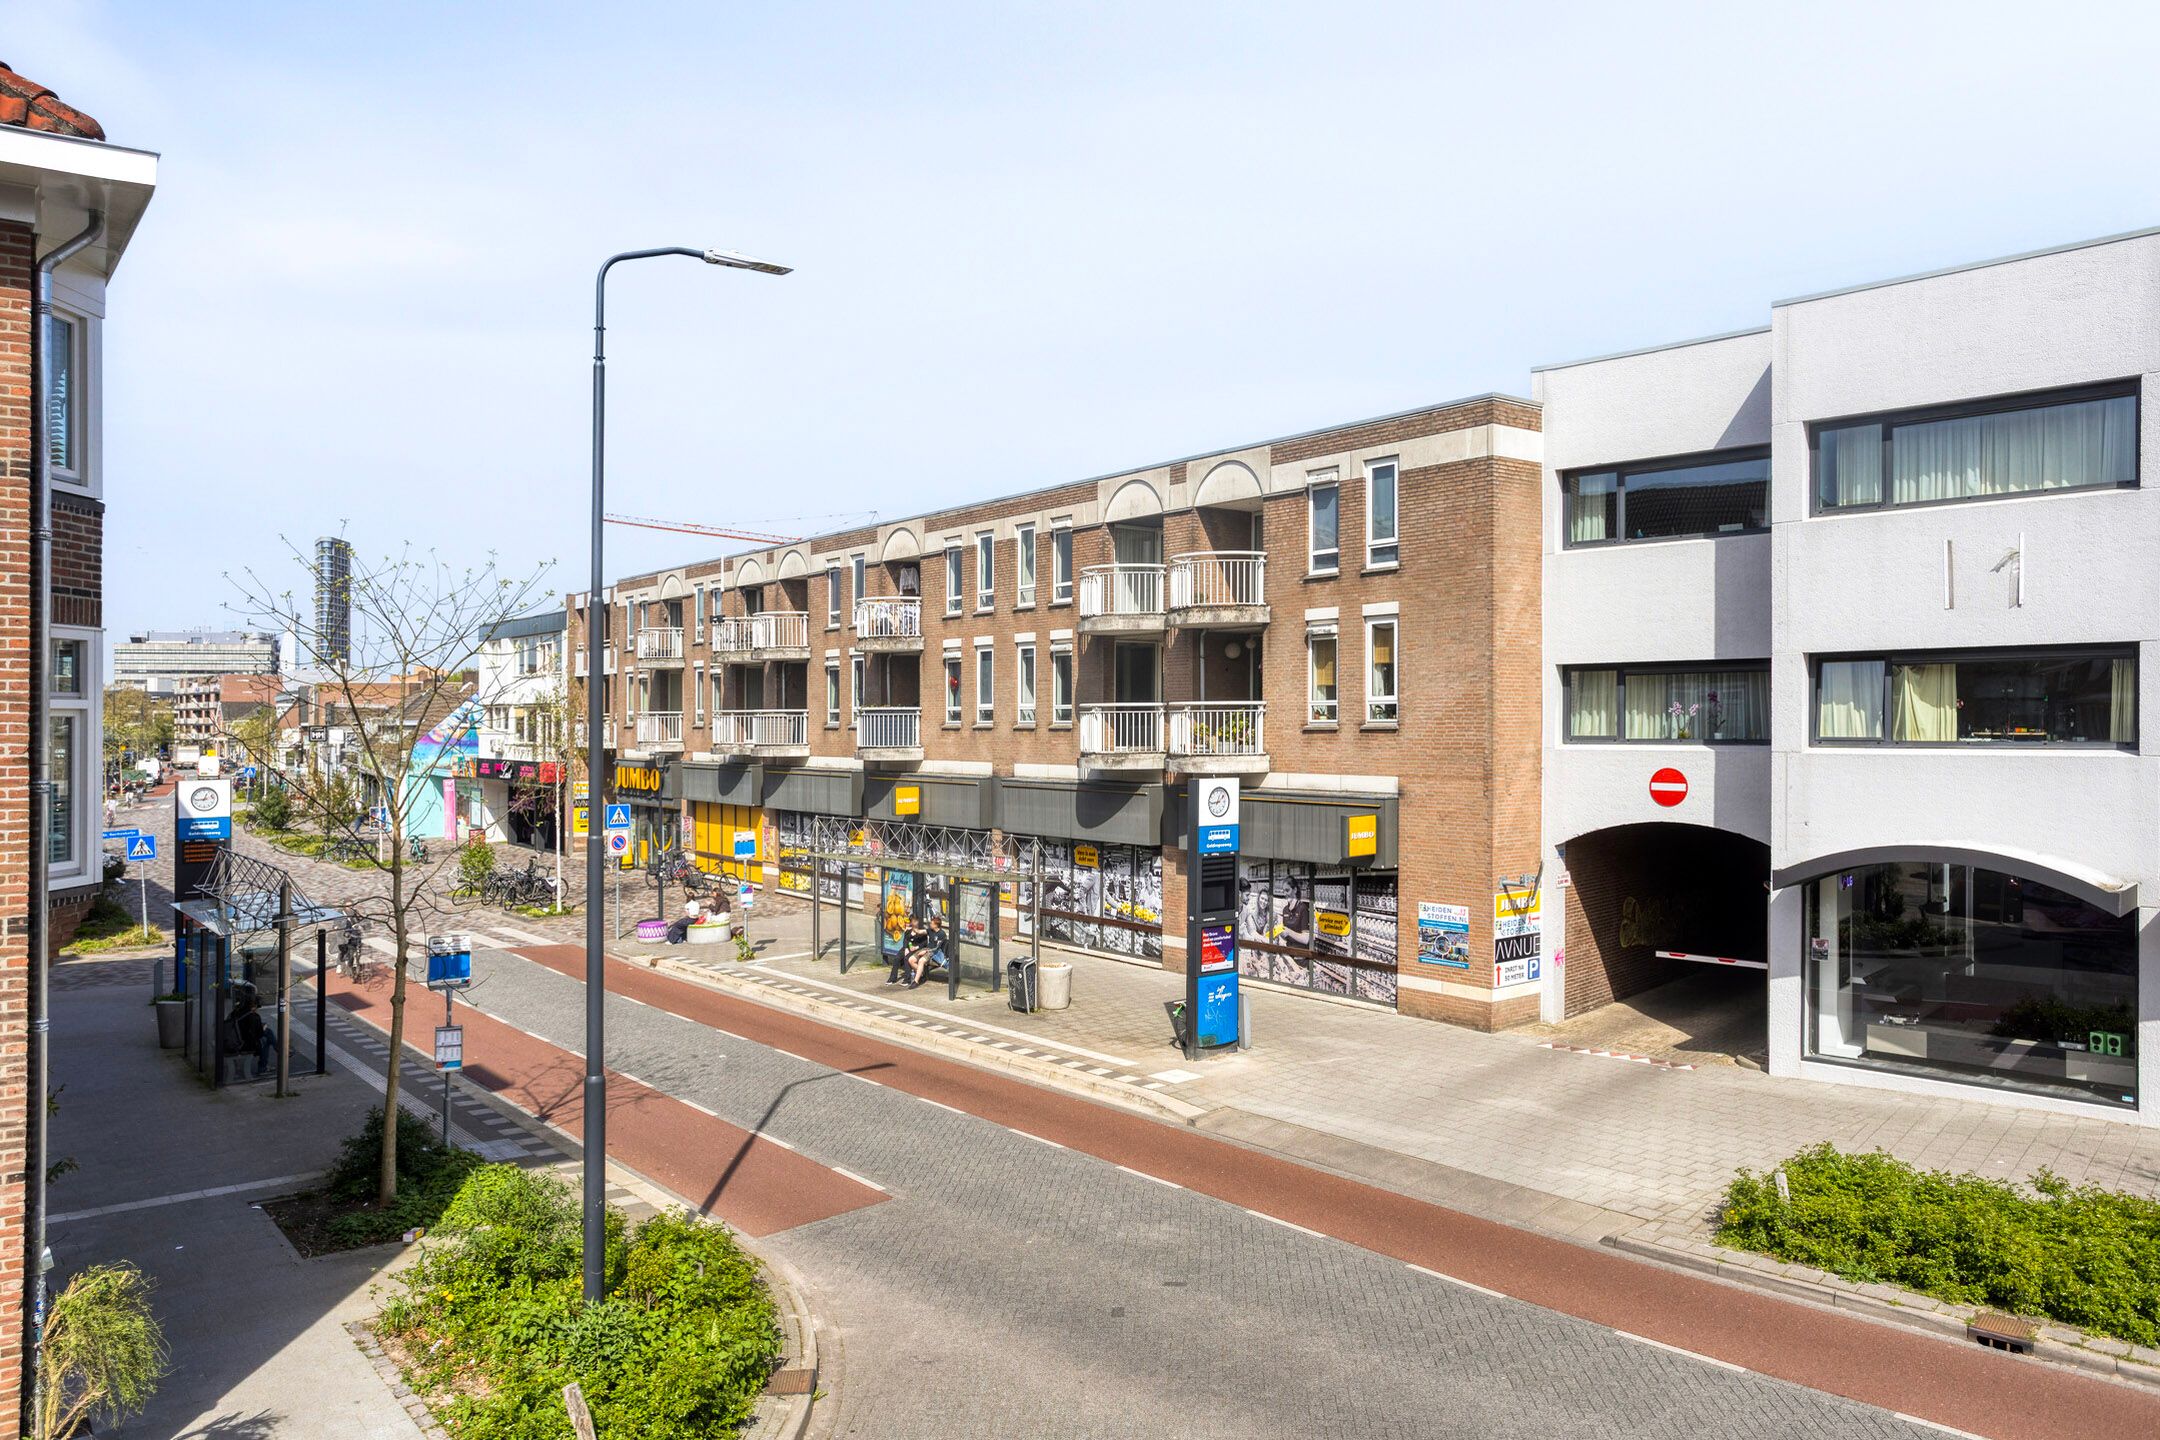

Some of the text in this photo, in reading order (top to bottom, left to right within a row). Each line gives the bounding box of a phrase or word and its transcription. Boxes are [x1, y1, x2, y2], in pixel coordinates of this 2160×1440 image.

[615, 766, 661, 792] JUMBO
[1350, 831, 1375, 841] JUMBO
[1500, 896, 1536, 912] JUMBO
[1495, 935, 1541, 960] AVNUE
[1529, 960, 1539, 979] P
